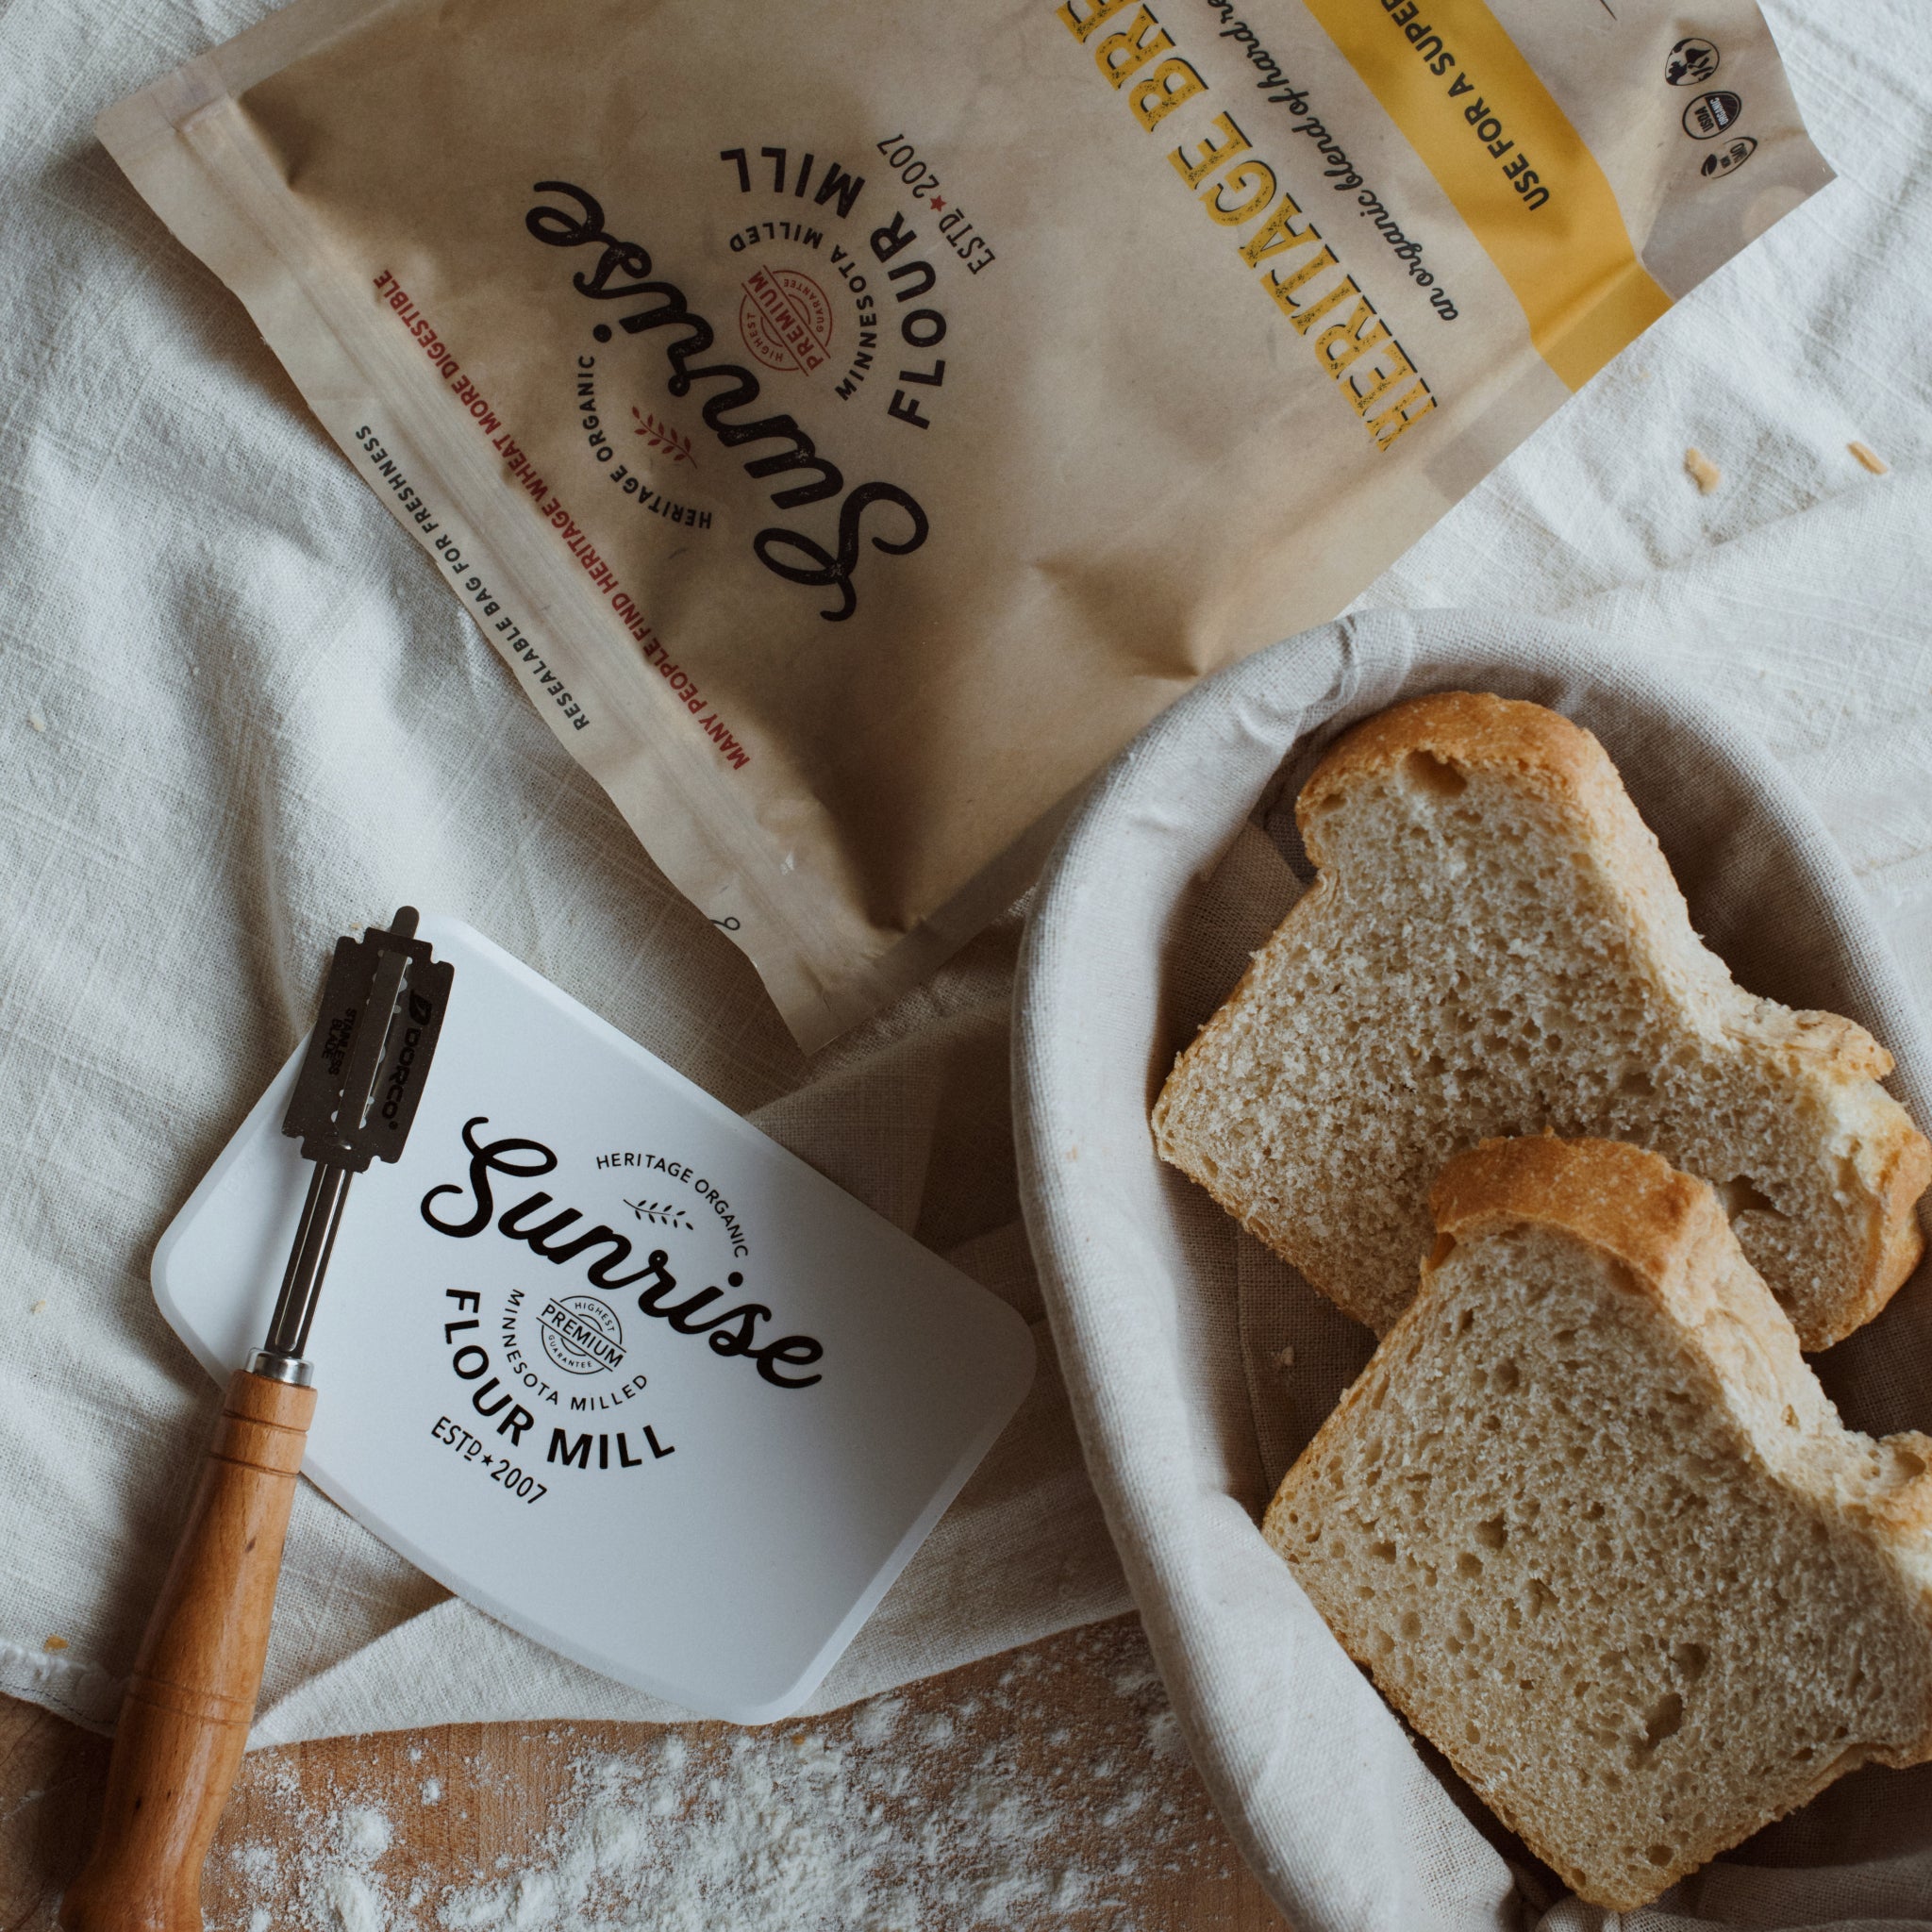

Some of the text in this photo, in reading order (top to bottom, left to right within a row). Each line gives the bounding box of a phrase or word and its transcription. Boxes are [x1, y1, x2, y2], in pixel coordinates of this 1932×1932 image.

[1219, 21, 1291, 90] hard
[1447, 72, 1475, 98] A
[1267, 87, 1309, 116] of
[1464, 96, 1515, 159] FOR
[1694, 106, 1714, 133] USDA
[1709, 97, 1729, 126] ORGANIC
[875, 133, 940, 199] 2007
[1291, 117, 1364, 192] blend
[1502, 153, 1550, 212] USE
[1357, 189, 1435, 287] organic
[720, 146, 947, 430] FLOUR MILL
[729, 221, 877, 402] MINNESOTA MILLED
[783, 278, 824, 333] GUARANTEE
[1166, 110, 1438, 453] HERITAGE
[1429, 287, 1458, 322] an
[746, 312, 784, 362] HIGHEST
[747, 271, 824, 371] PREMIUM
[525, 180, 929, 623] Sunrise
[576, 355, 713, 530] HERITAGE ORGANIC
[373, 269, 751, 771] MANY PEOPLE FIND HERITAGE WHEAT MORE DIGESTIBLE
[355, 425, 591, 731] RESEALABLE BAG FOR FRESHNESS
[321, 1018, 340, 1060] BLADE
[327, 1008, 358, 1076] STAINLESS
[381, 1027, 423, 1122] DORCO
[596, 1152, 749, 1258] HERITAGE ORGANIC
[420, 1116, 824, 1390] Sunrise
[502, 1289, 647, 1411] MINNESOTA MILLED
[541, 1304, 625, 1368] PREMIUM
[575, 1302, 615, 1331] HIGHEST
[444, 1289, 675, 1469] FLOUR MILL
[548, 1334, 591, 1369] GUARANTEE
[490, 1458, 548, 1505] 2007
